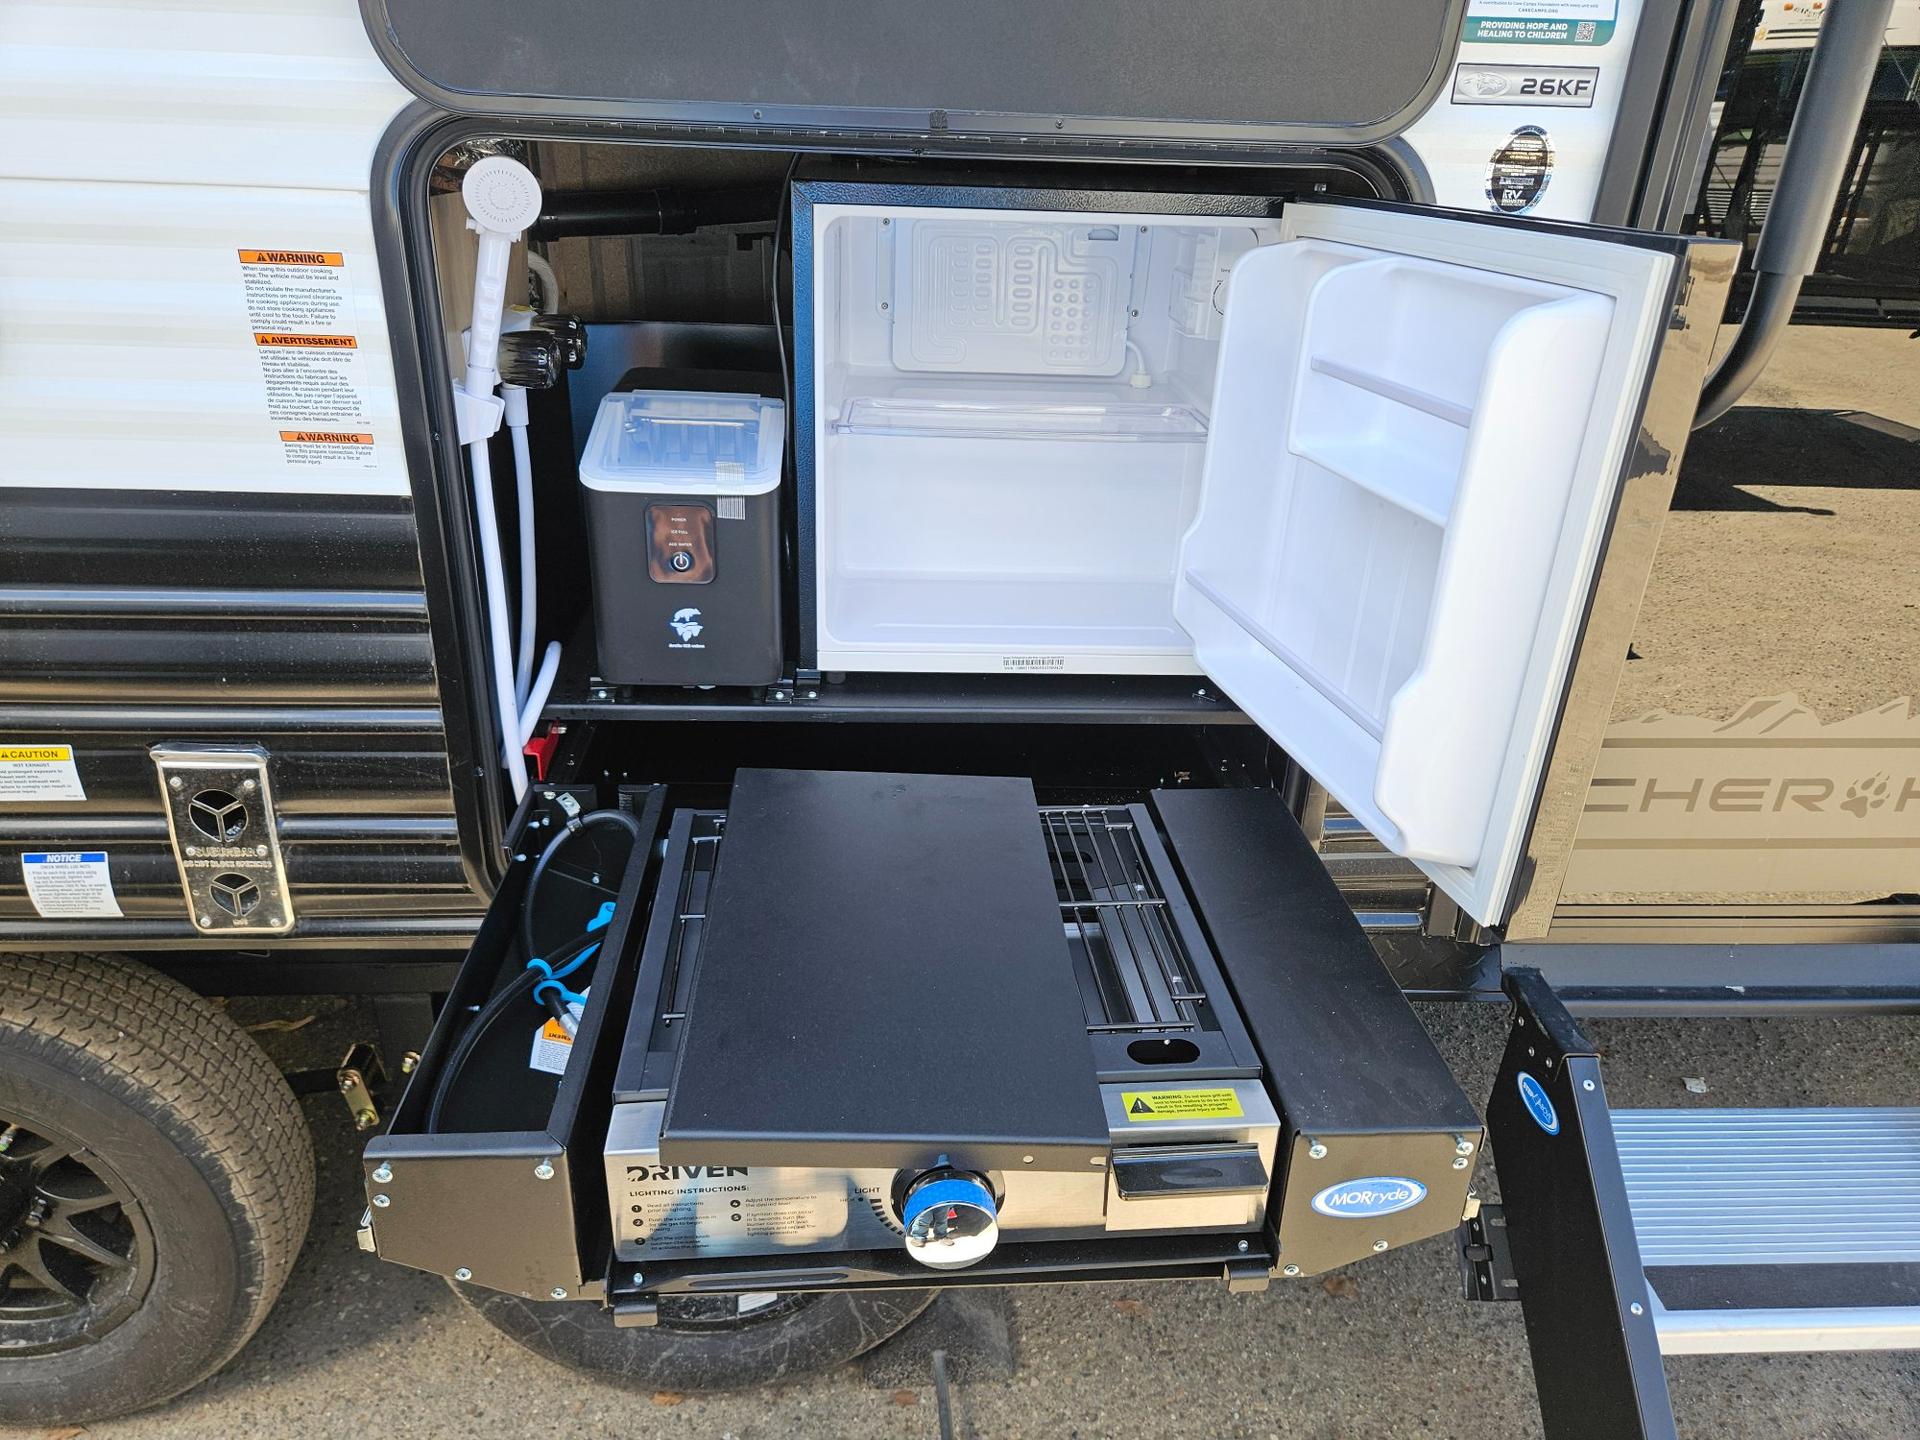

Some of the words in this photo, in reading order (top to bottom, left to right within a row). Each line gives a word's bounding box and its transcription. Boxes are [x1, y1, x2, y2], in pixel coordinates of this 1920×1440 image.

[1480, 21, 1525, 29] PROVIDING
[1527, 31, 1568, 39] CHILDREN
[1520, 78, 1591, 96] 26KF
[267, 253, 325, 263] WARNING
[272, 337, 352, 346] AVERTISSEMENT
[307, 433, 359, 442] WARNING
[626, 1165, 748, 1182] DRIVEN
[677, 1185, 750, 1194] INSTRUCTIONS:
[1329, 1188, 1408, 1206] MORryde
